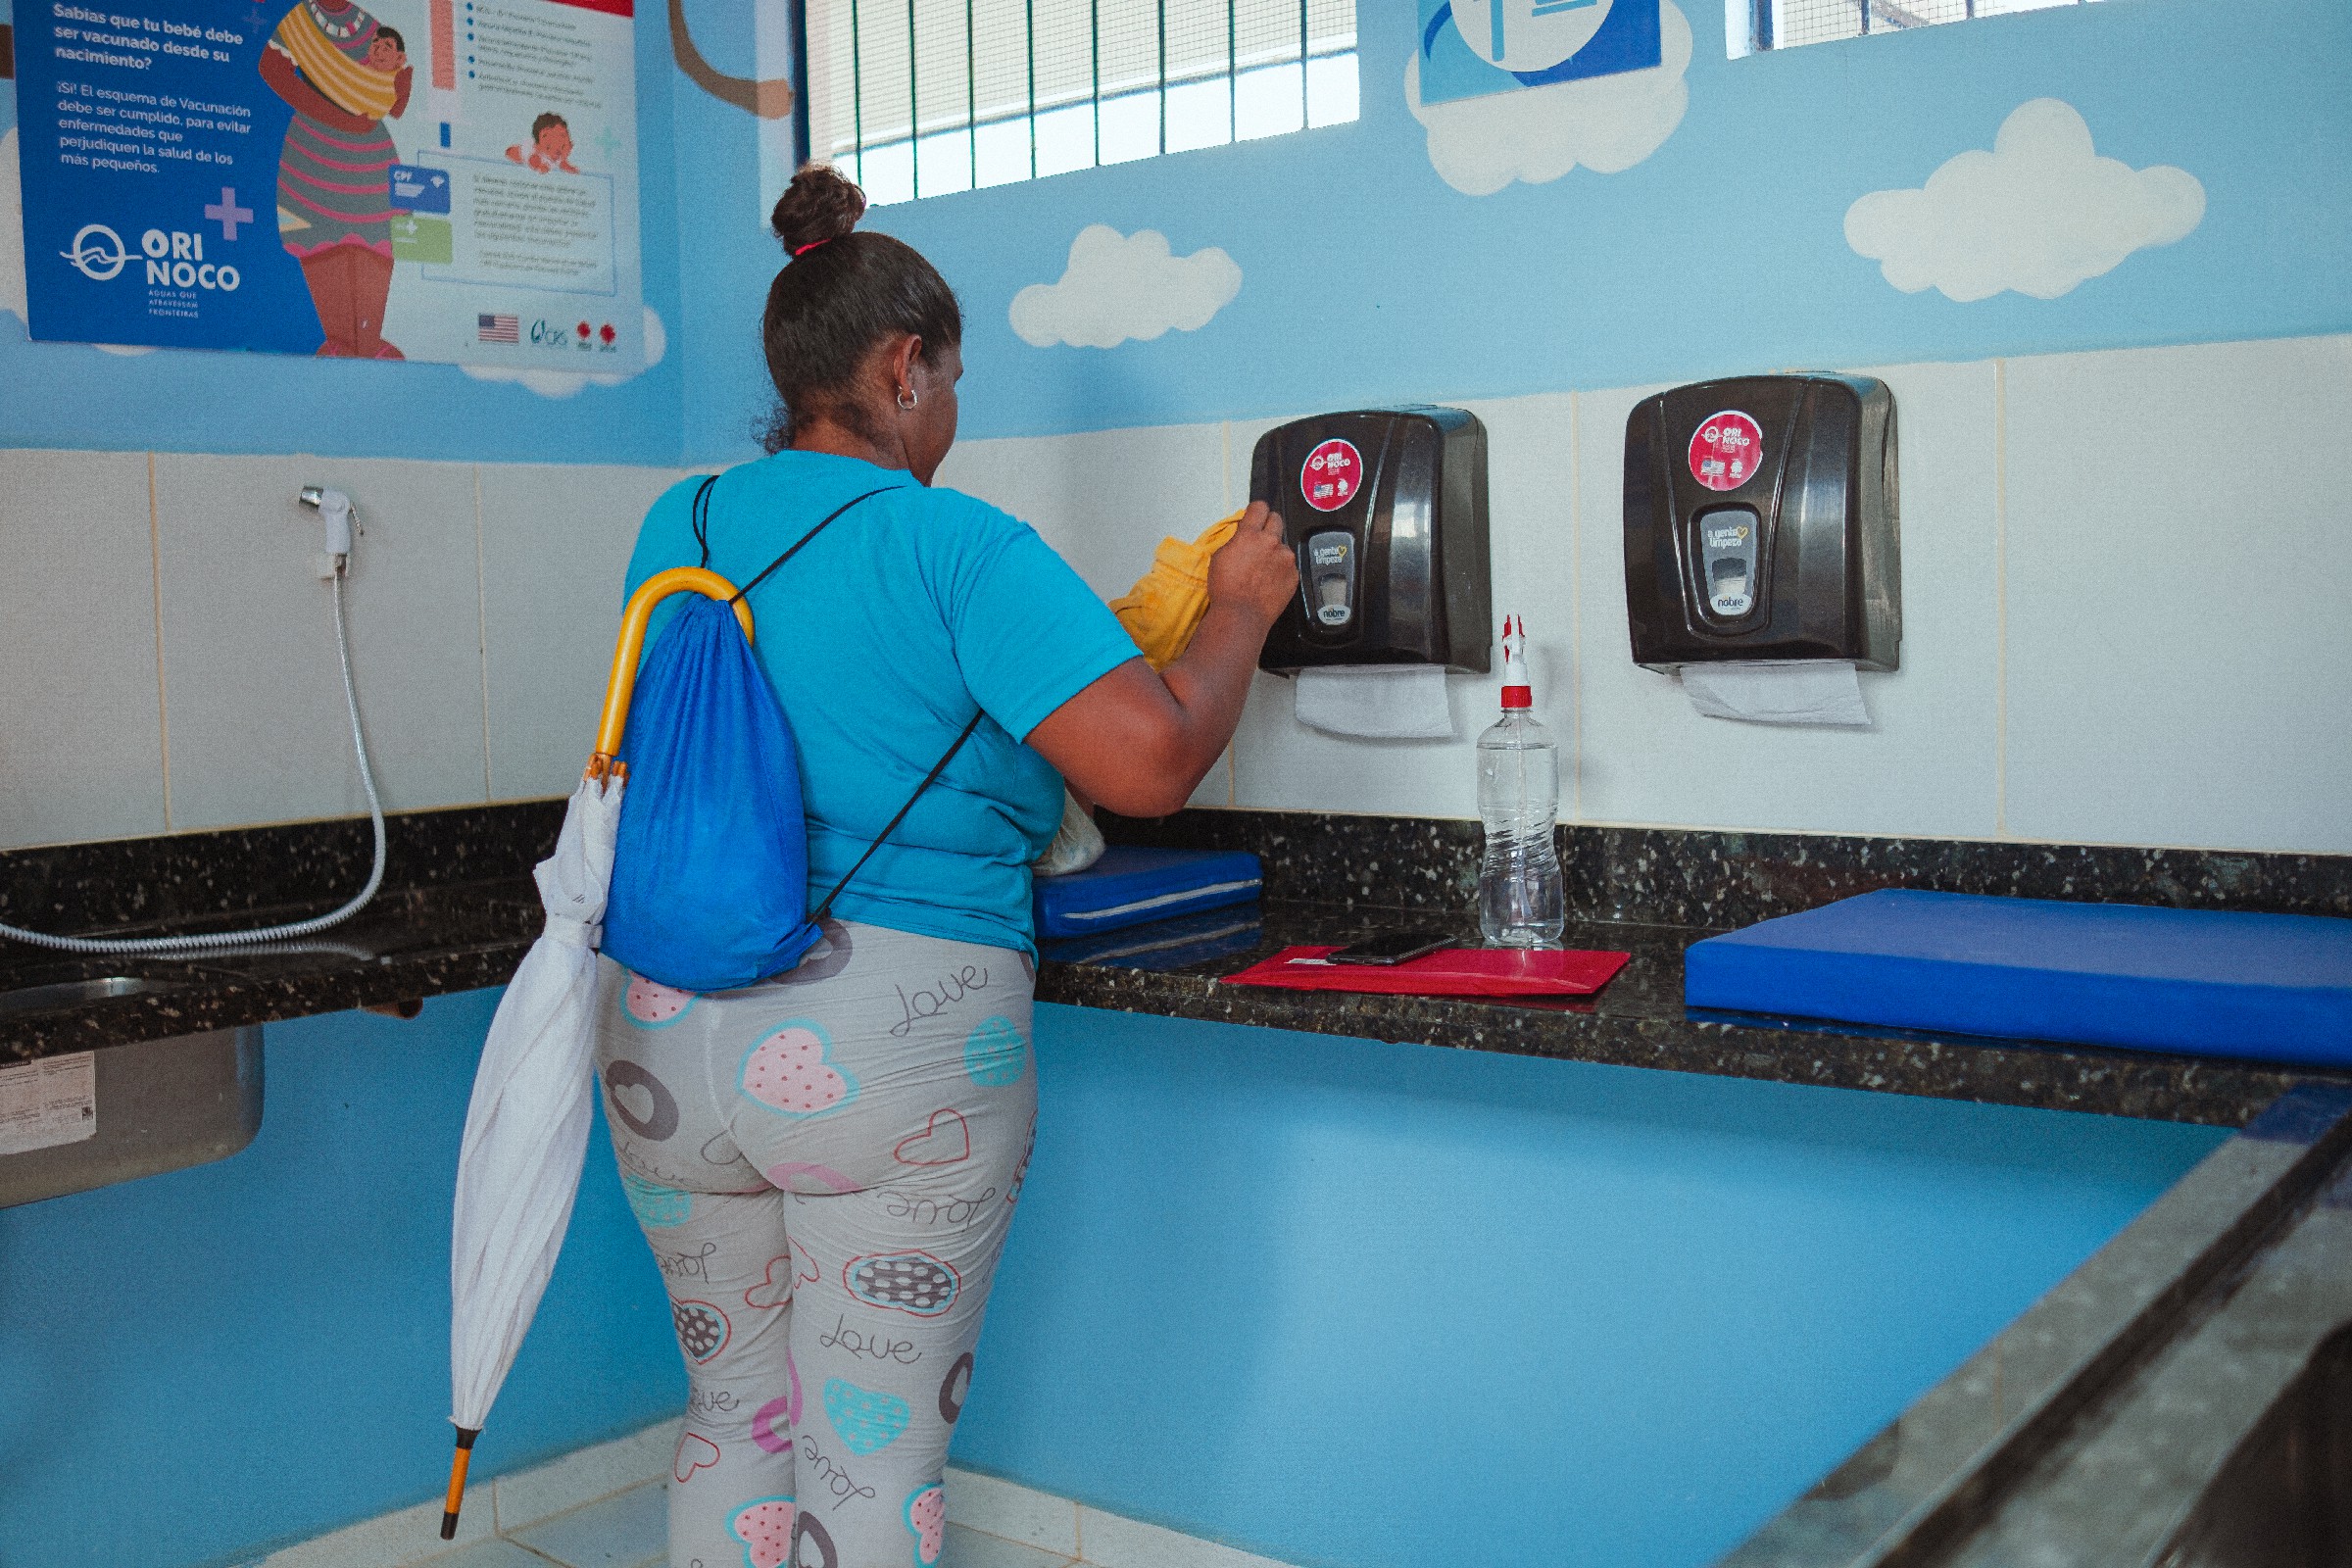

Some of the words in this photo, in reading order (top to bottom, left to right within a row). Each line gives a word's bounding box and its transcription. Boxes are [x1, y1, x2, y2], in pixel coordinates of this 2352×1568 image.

[54, 26, 78, 40] ser
[82, 30, 160, 52] vacunado
[164, 41, 209, 60] desde
[213, 49, 230, 63] su
[110, 15, 140, 29] que
[144, 18, 160, 32] tu
[164, 21, 202, 39] bebé
[205, 27, 243, 45] debe
[55, 46, 152, 71] nacimiento?
[81, 84, 94, 97] El
[97, 89, 158, 106] esquema
[161, 95, 177, 108] de
[179, 98, 251, 118] Vacunación
[58, 100, 93, 115] debe
[96, 105, 116, 117] ser
[120, 108, 183, 126] cumplido,
[186, 117, 215, 130] para
[218, 121, 251, 134] evitar
[59, 119, 155, 140] enfermedades
[159, 129, 183, 144] que
[60, 136, 140, 155] perjudiquen
[143, 144, 155, 156] la
[158, 147, 192, 161] salud
[196, 151, 212, 163] de
[215, 153, 233, 166] los
[61, 153, 88, 167] más
[92, 157, 160, 173] pequeños.
[141, 229, 203, 261] ORI
[147, 260, 240, 292] NOCO
[1323, 608, 1346, 618] nobre
[1717, 596, 1743, 608] nobre
